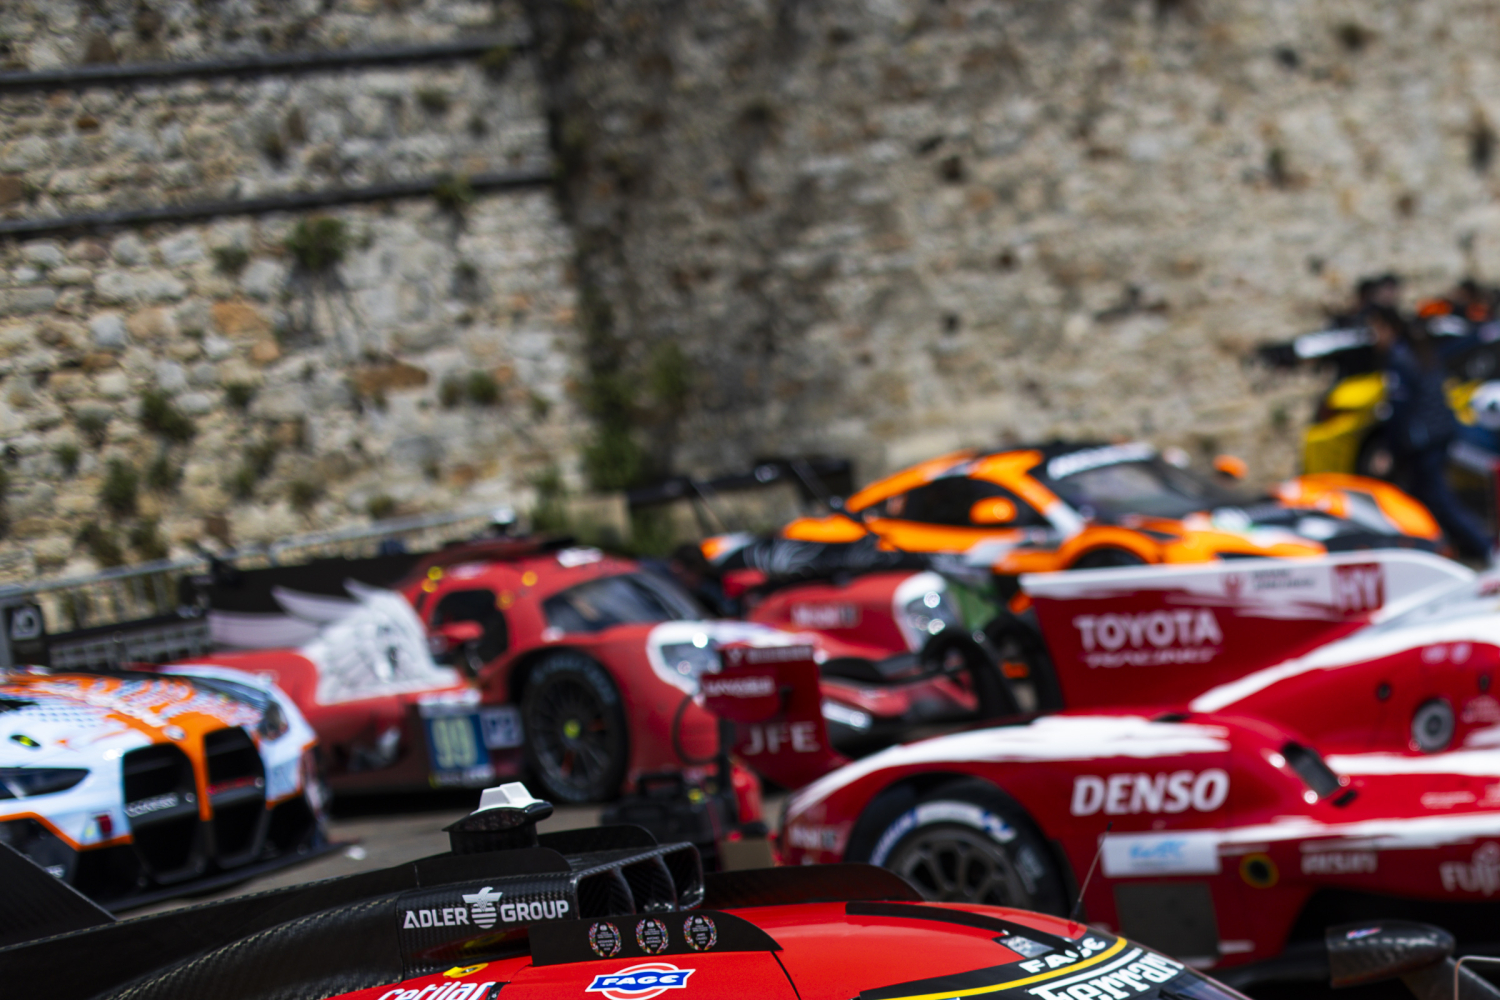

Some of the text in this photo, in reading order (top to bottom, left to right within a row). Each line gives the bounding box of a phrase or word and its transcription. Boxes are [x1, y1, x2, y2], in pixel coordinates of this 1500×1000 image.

[1072, 609, 1223, 650] TOYOTA
[741, 721, 821, 756] JFE
[1070, 768, 1230, 816] DENSO
[403, 900, 569, 929] ADLER GROUP
